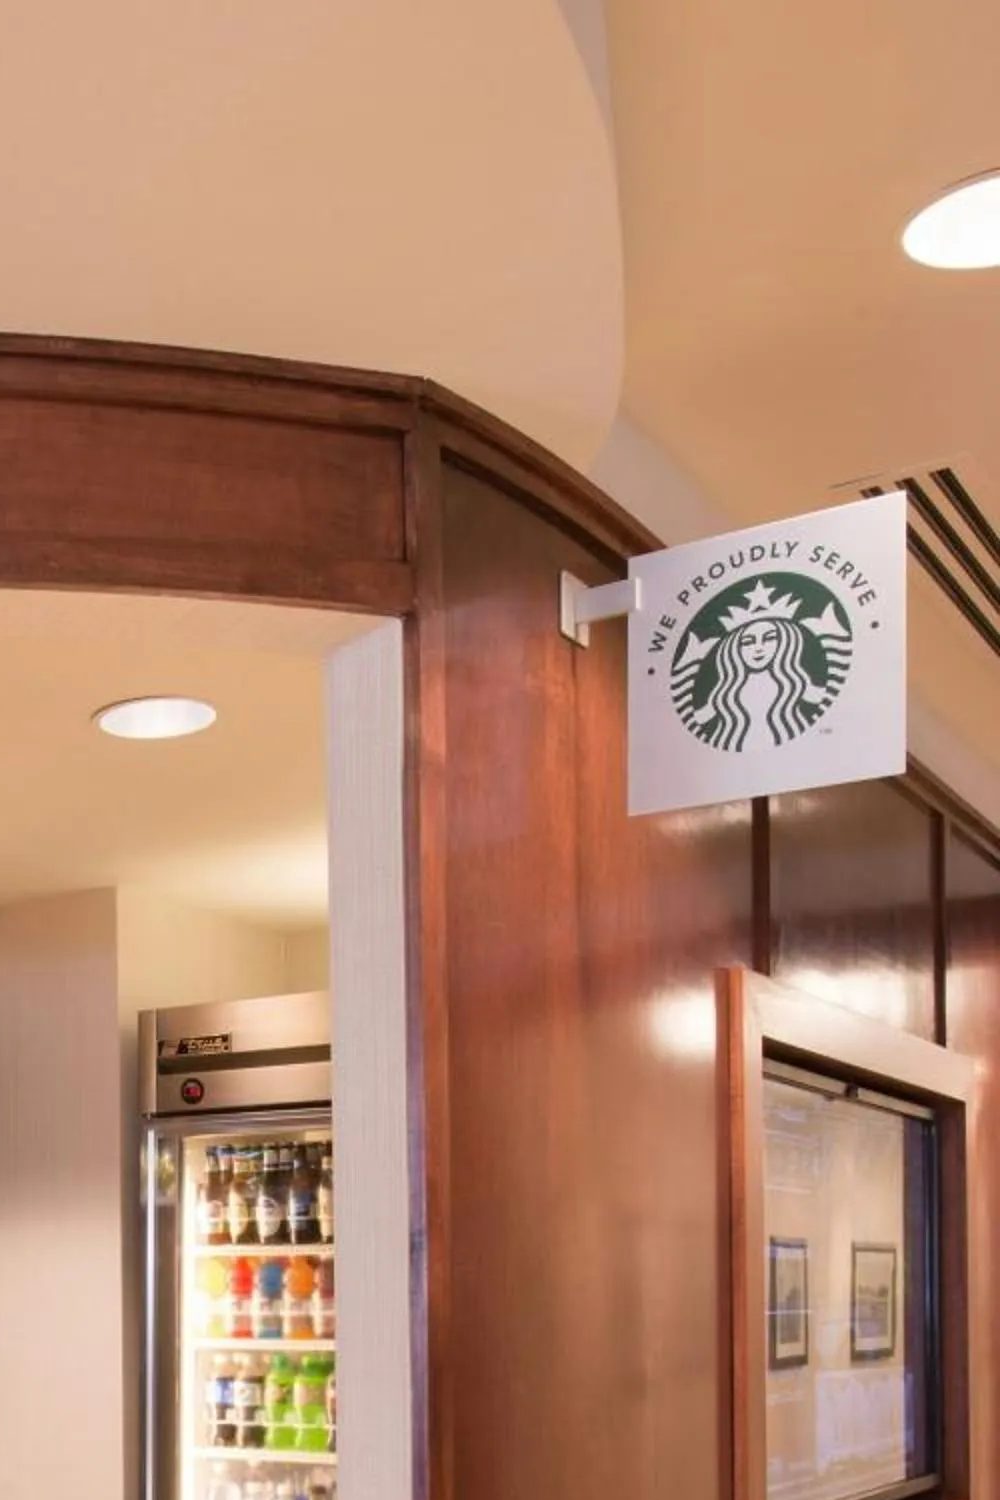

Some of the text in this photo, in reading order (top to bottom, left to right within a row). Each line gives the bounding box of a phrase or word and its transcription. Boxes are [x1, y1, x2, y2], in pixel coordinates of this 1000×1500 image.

[648, 541, 877, 654] WE PROUDLY SERVE
